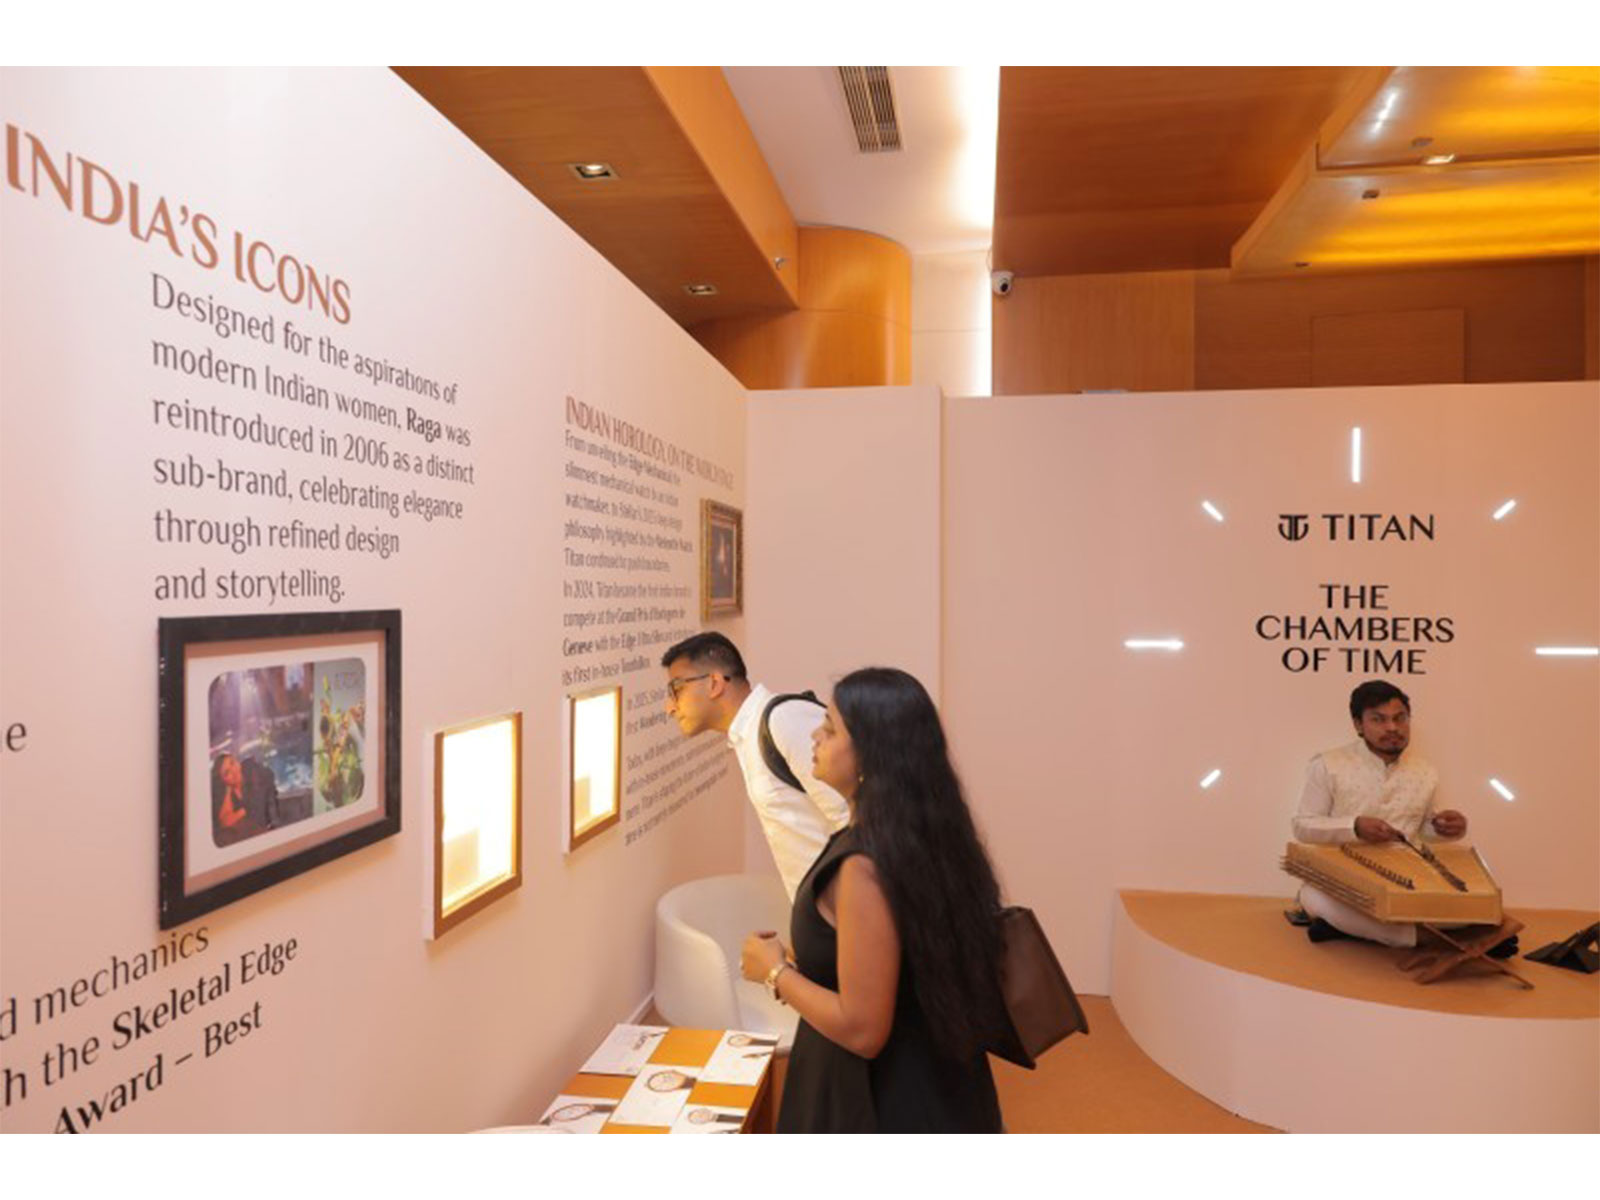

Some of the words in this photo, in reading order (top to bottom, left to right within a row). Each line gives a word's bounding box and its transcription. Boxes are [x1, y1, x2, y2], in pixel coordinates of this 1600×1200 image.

[234, 231, 352, 324] ICONS
[150, 272, 275, 344] Designed
[283, 320, 313, 357] for
[318, 336, 349, 370] the
[353, 352, 441, 401] aspirations
[443, 383, 458, 405] of
[151, 339, 257, 391] modern
[264, 364, 329, 410] Indian
[334, 391, 402, 431] women,
[406, 406, 442, 444] Raga
[445, 424, 471, 448] was
[565, 395, 611, 441] INDIAN
[152, 398, 314, 454] reintroduced
[320, 429, 338, 459] in
[343, 433, 389, 470] 2006
[392, 450, 411, 473] as
[414, 456, 423, 475] a
[426, 453, 475, 487] distinct
[153, 455, 293, 502] sub-brand,
[299, 475, 400, 519] celebrating
[402, 489, 464, 522] elegance
[153, 508, 261, 555] through
[268, 520, 340, 552] refined
[345, 524, 400, 559] design
[1321, 513, 1435, 542] TITAN
[564, 547, 585, 568] Titan
[154, 567, 207, 602] and
[215, 568, 346, 607] storytelling.
[1319, 583, 1389, 611] THE
[1255, 614, 1455, 644] CHAMBERS
[1281, 646, 1330, 674] OF
[1338, 647, 1427, 676] TIME
[0, 722, 28, 754] e
[34, 925, 210, 1025] mechanics
[0, 1068, 27, 1108] h
[42, 1036, 100, 1087] the
[112, 963, 231, 1051] Skeletal
[240, 936, 298, 986] Edge
[53, 1053, 164, 1134] Award
[204, 1001, 263, 1058] Best
